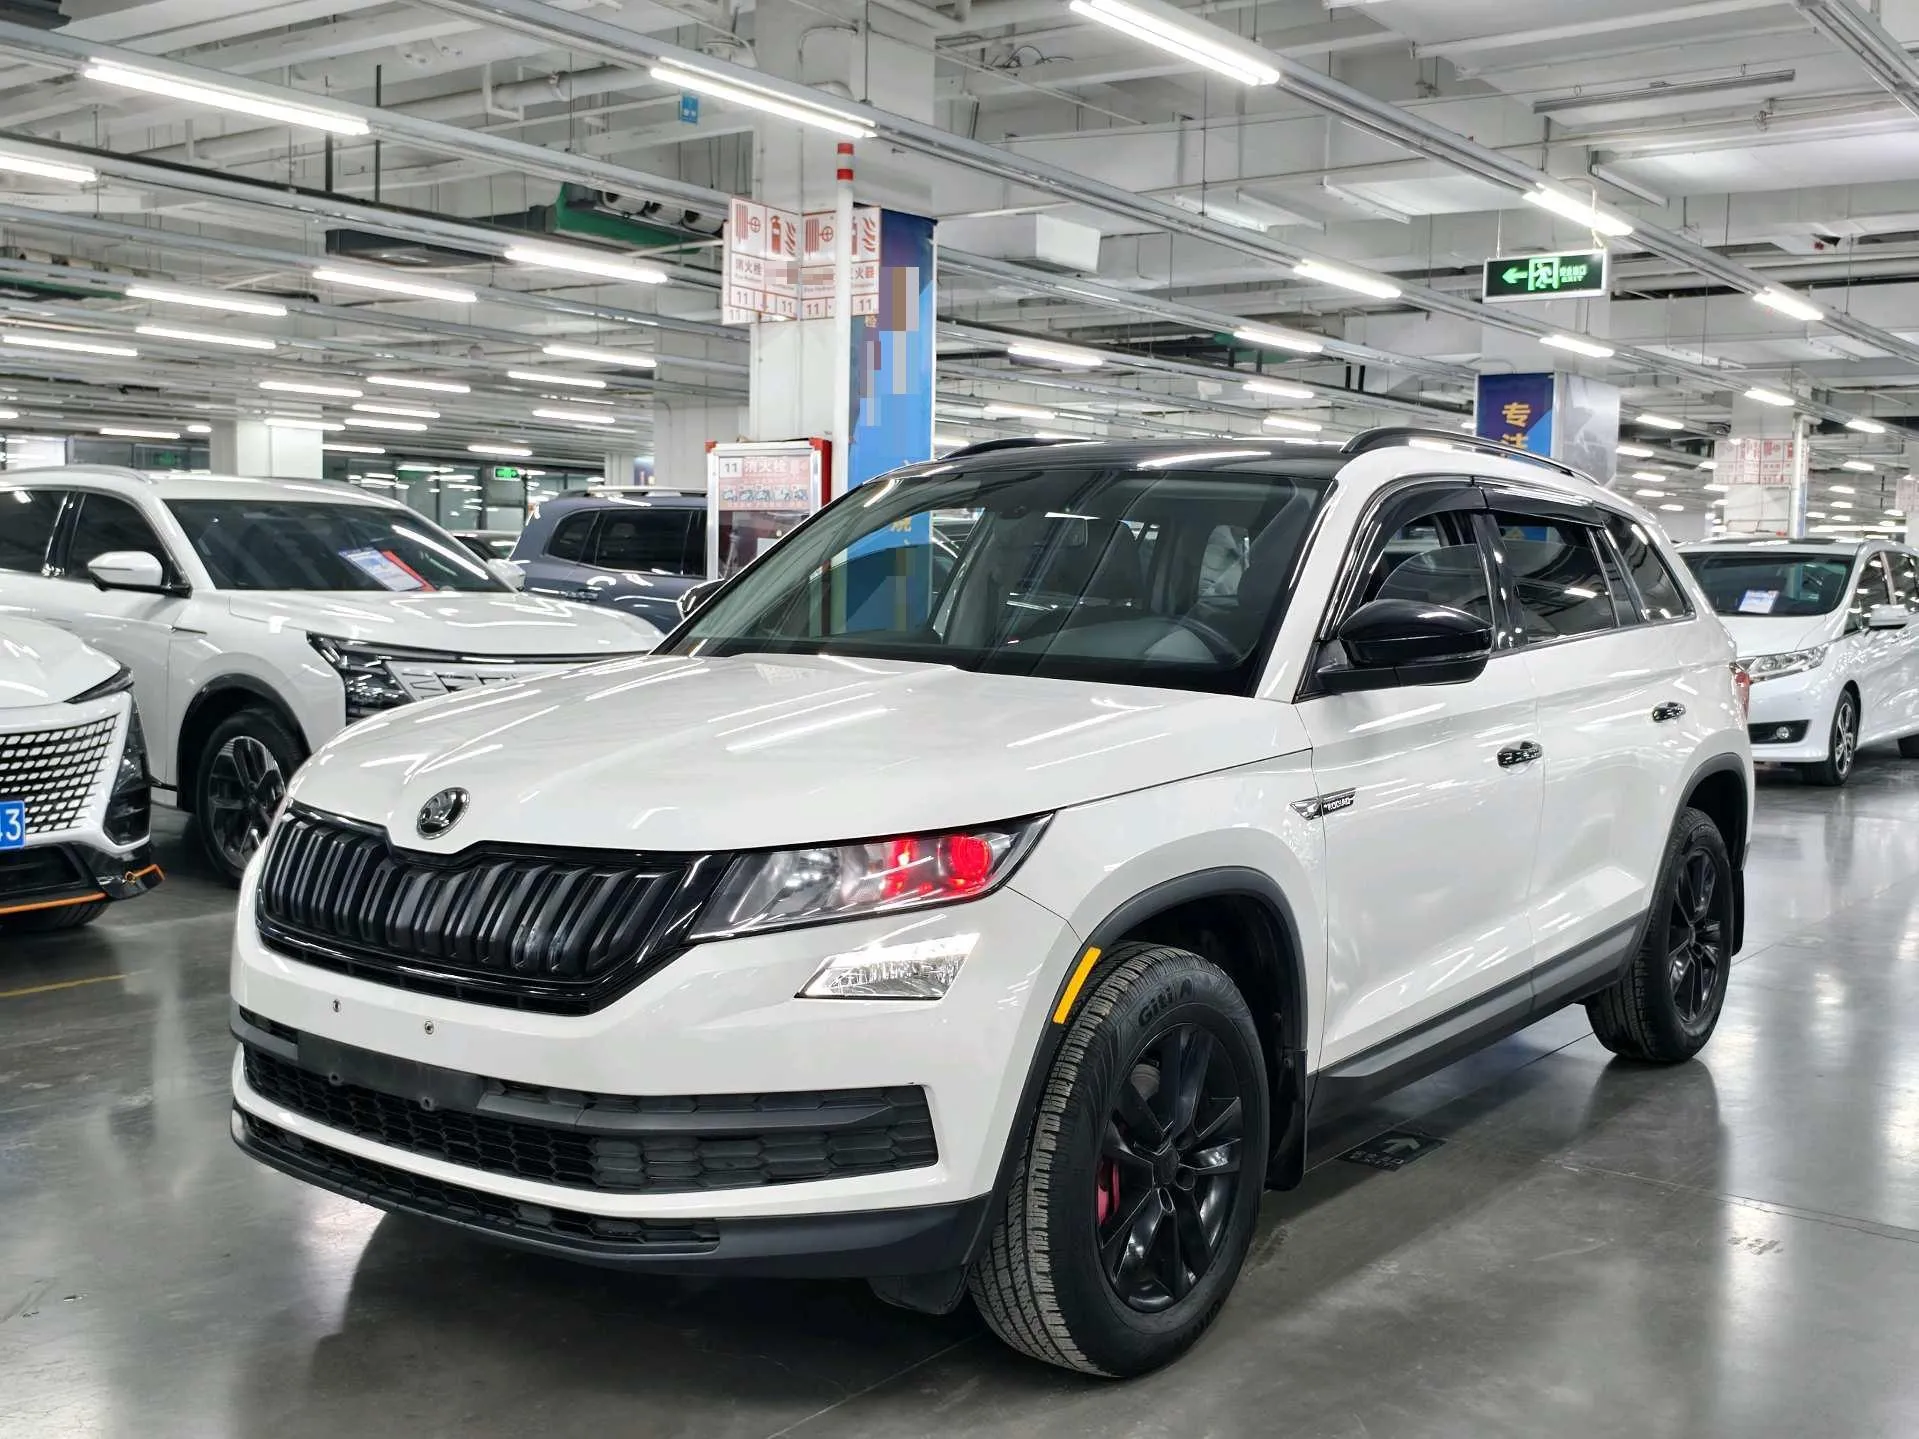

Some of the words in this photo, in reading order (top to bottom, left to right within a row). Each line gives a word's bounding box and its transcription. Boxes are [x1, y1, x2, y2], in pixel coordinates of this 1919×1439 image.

[736, 291, 748, 304] 11
[781, 301, 792, 313] 11
[806, 303, 819, 315] 11
[859, 299, 873, 312] 11
[724, 463, 738, 473] 11
